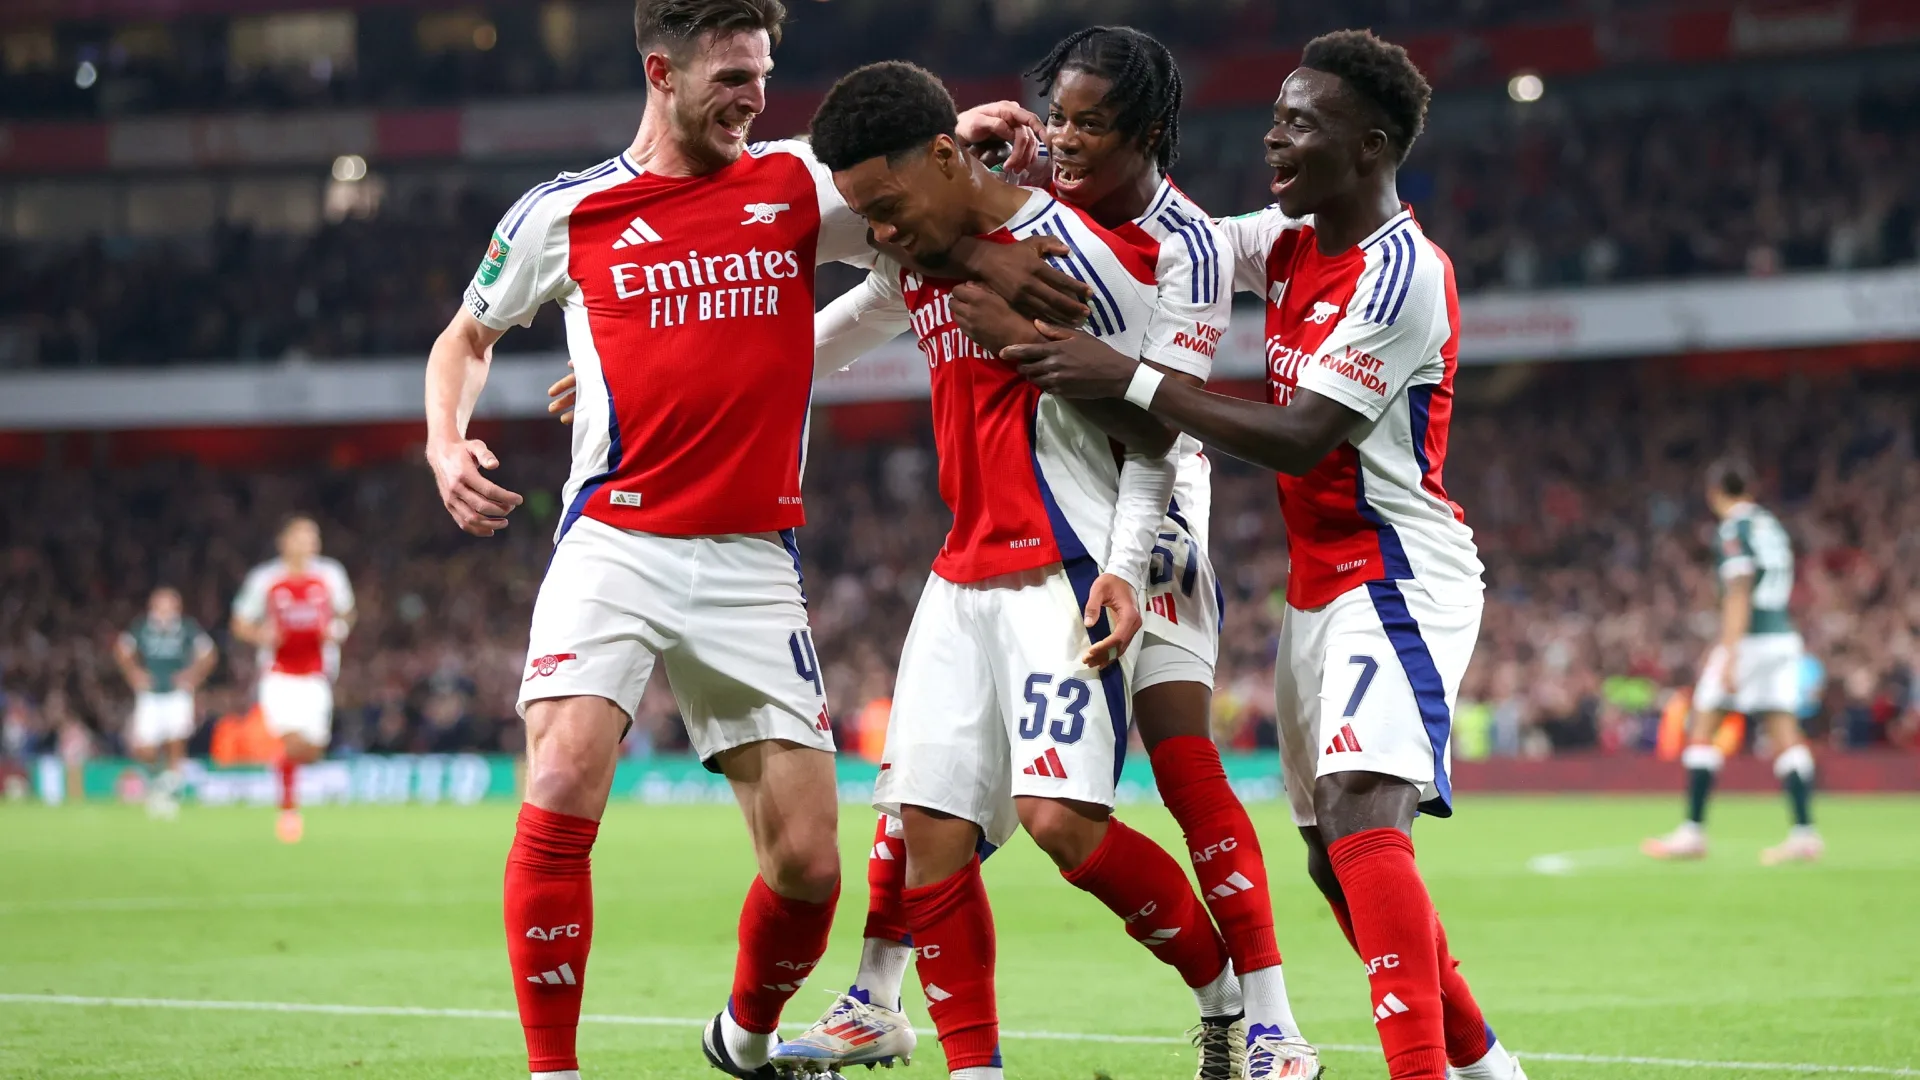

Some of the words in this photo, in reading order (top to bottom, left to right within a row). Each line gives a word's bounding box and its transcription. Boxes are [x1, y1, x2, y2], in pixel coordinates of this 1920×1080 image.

[608, 246, 799, 300] Emirates
[650, 294, 688, 329] FLY
[699, 285, 779, 321] BETTER
[1319, 354, 1388, 397] RWANDA
[1345, 345, 1385, 373] VISIT
[1010, 537, 1041, 549] HEAT.RDY
[1336, 558, 1367, 573] HEAT.RDY
[787, 629, 823, 697] 4
[1341, 654, 1380, 719] 7
[1019, 671, 1093, 746] 53
[1193, 837, 1238, 864] AFC
[526, 923, 580, 941] AFC
